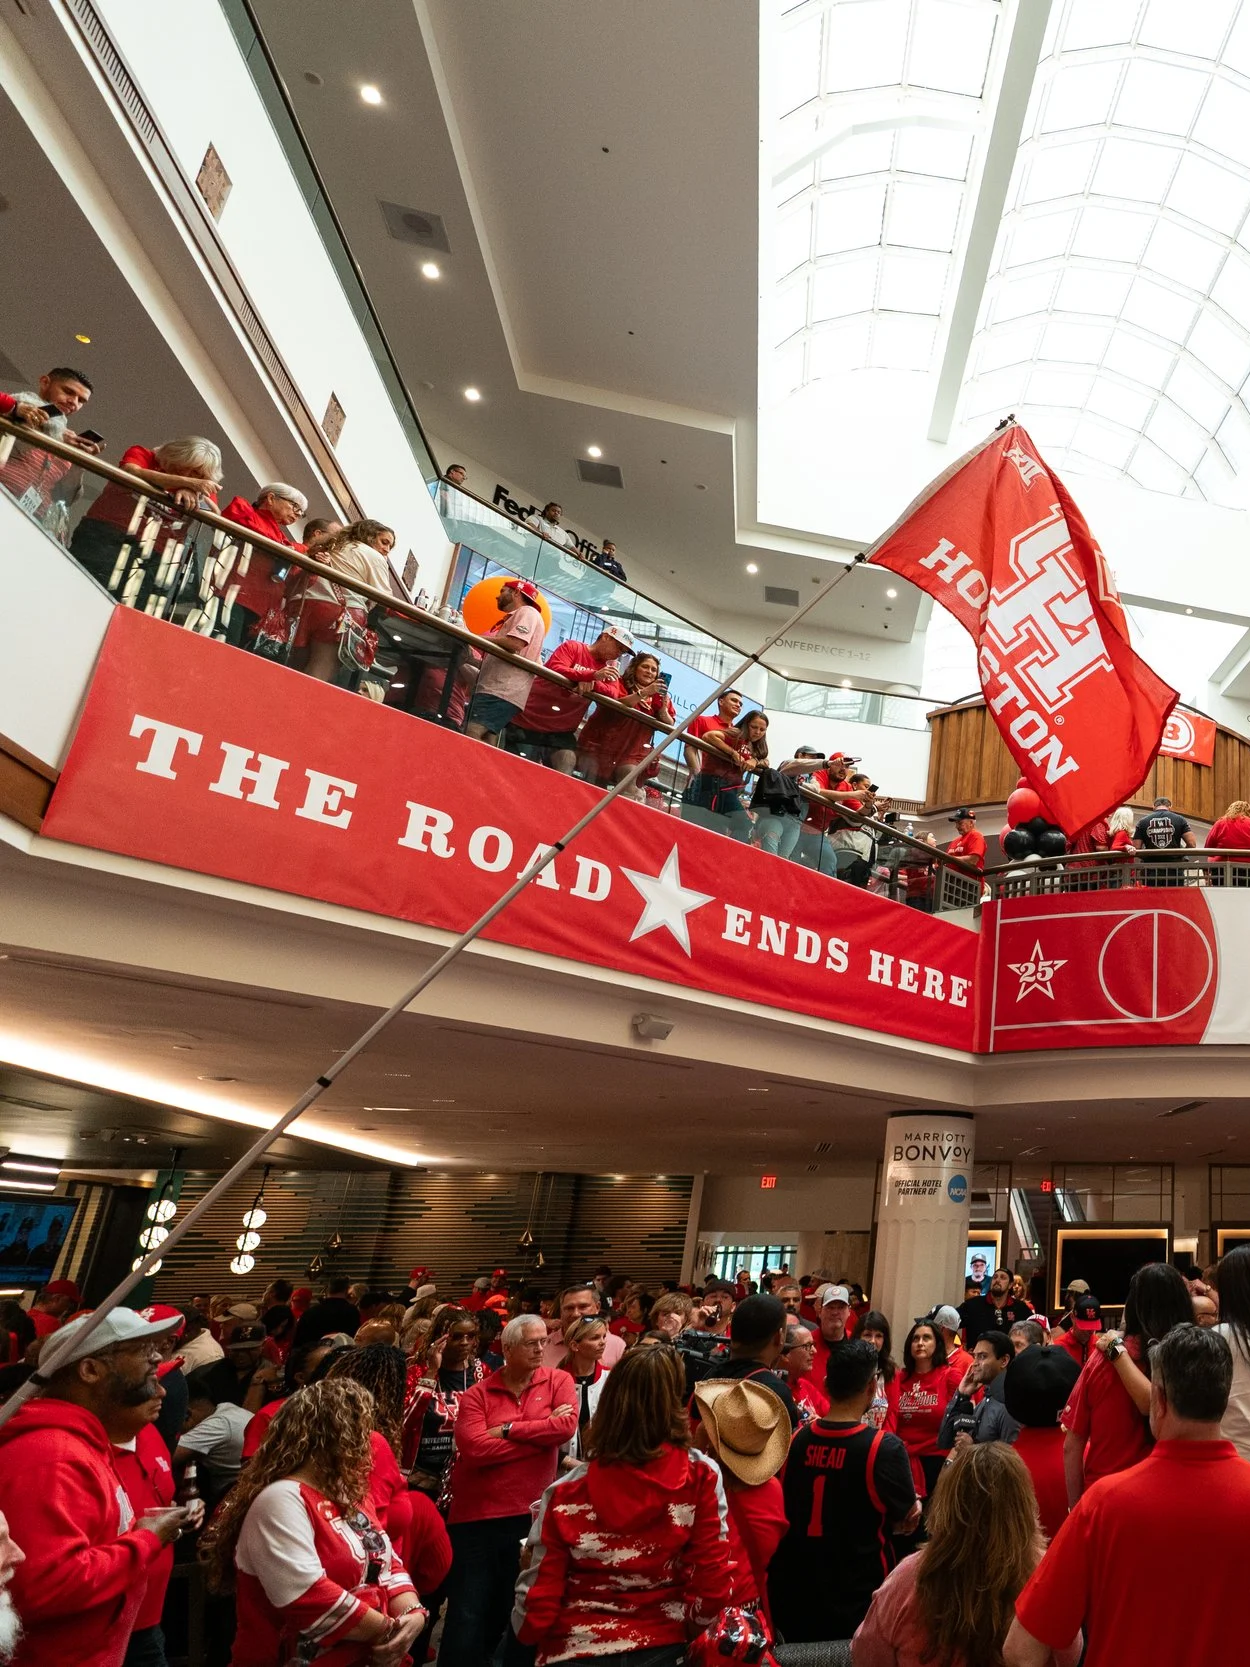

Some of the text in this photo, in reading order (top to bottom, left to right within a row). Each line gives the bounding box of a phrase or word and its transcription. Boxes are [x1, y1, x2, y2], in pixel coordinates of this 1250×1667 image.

[918, 537, 1080, 786] HOSTON
[129, 714, 970, 1008] THE ROAD ENDS HERE
[1019, 960, 1054, 983] 25
[904, 1132, 966, 1142] MARRIOTT
[760, 1176, 776, 1188] EXIT
[894, 1180, 942, 1188] OFFICIAL HOTEL
[898, 1188, 938, 1196] PARTNER OF
[804, 1445, 847, 1470] SHEAD
[806, 1475, 828, 1538] 1
